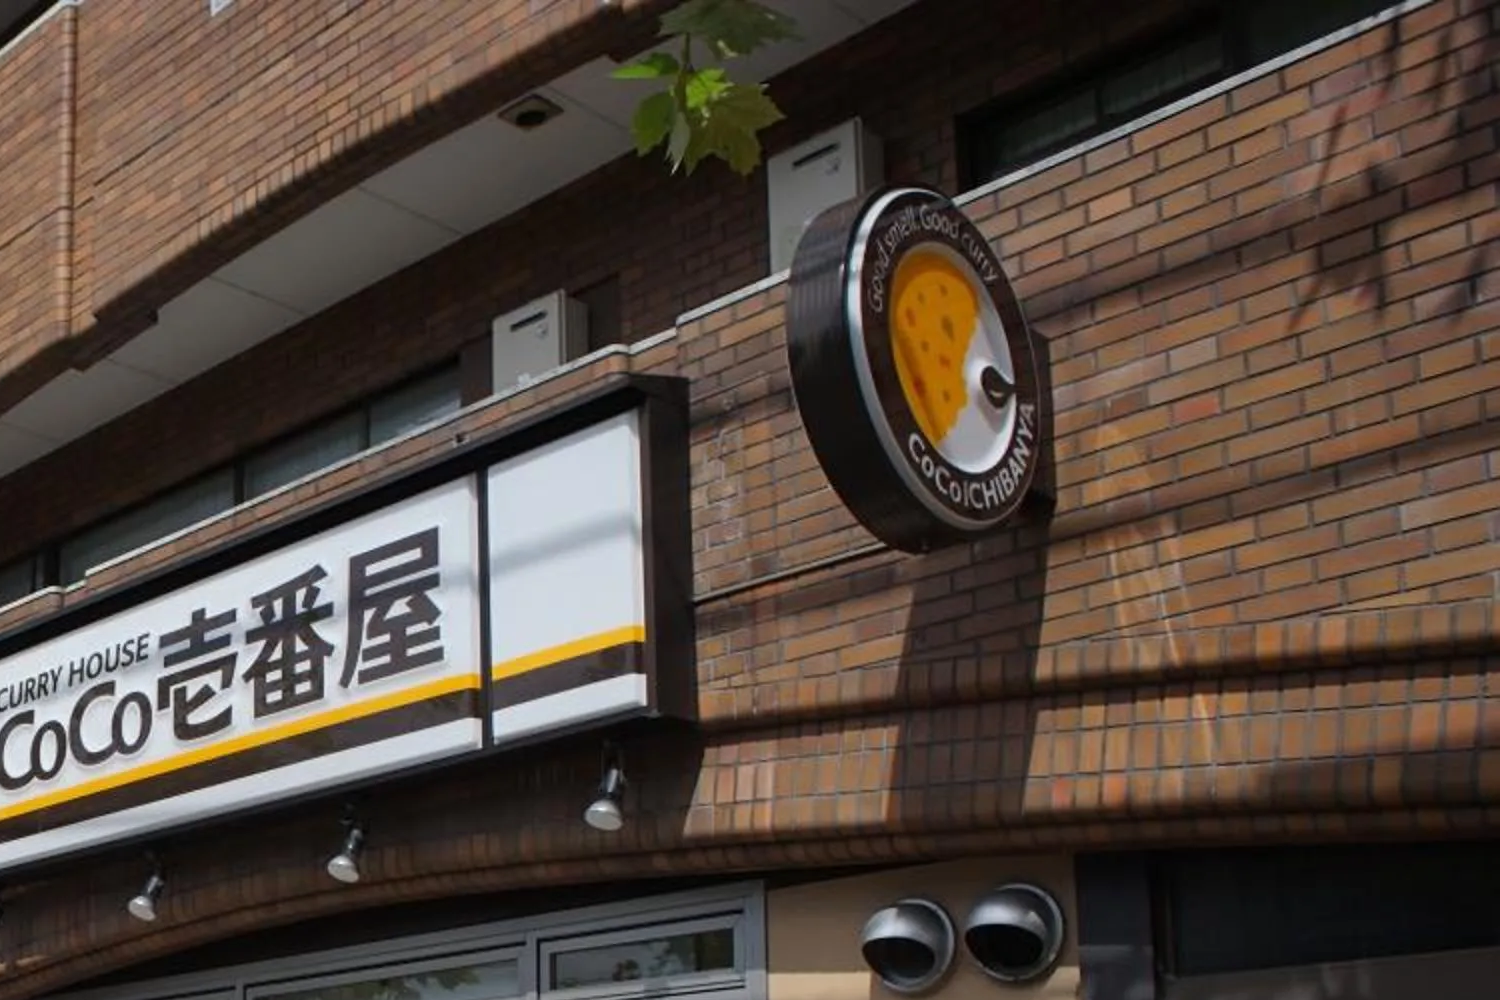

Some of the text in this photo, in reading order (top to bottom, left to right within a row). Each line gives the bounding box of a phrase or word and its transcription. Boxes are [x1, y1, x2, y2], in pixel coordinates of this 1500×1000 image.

[869, 236, 890, 313] Good
[920, 204, 960, 239] Good
[961, 233, 998, 282] curry
[68, 633, 150, 687] HOUSE
